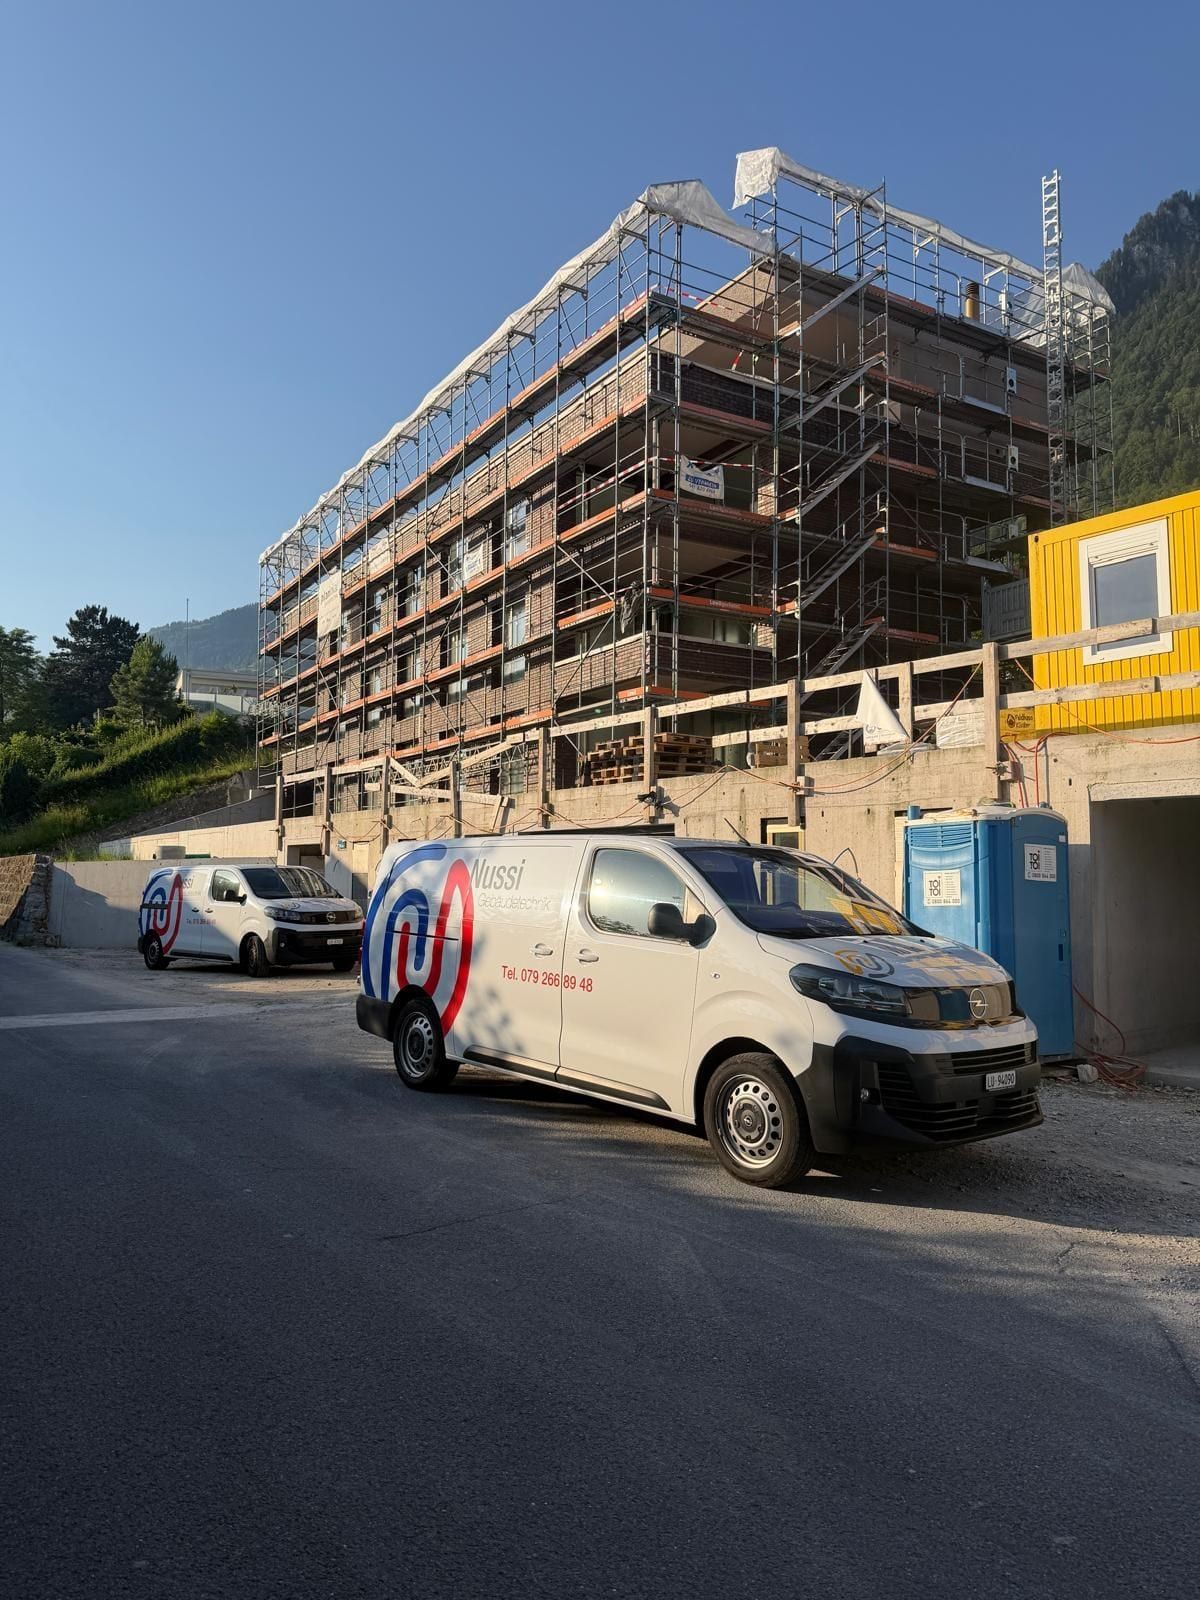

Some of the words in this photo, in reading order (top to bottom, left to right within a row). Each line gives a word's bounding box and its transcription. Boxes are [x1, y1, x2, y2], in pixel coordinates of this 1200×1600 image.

[470, 858, 526, 891] Nussi
[501, 965, 518, 981] Tel.
[521, 968, 539, 984] 079
[541, 971, 561, 988] 266
[563, 974, 577, 990] 89
[579, 977, 593, 993] 48
